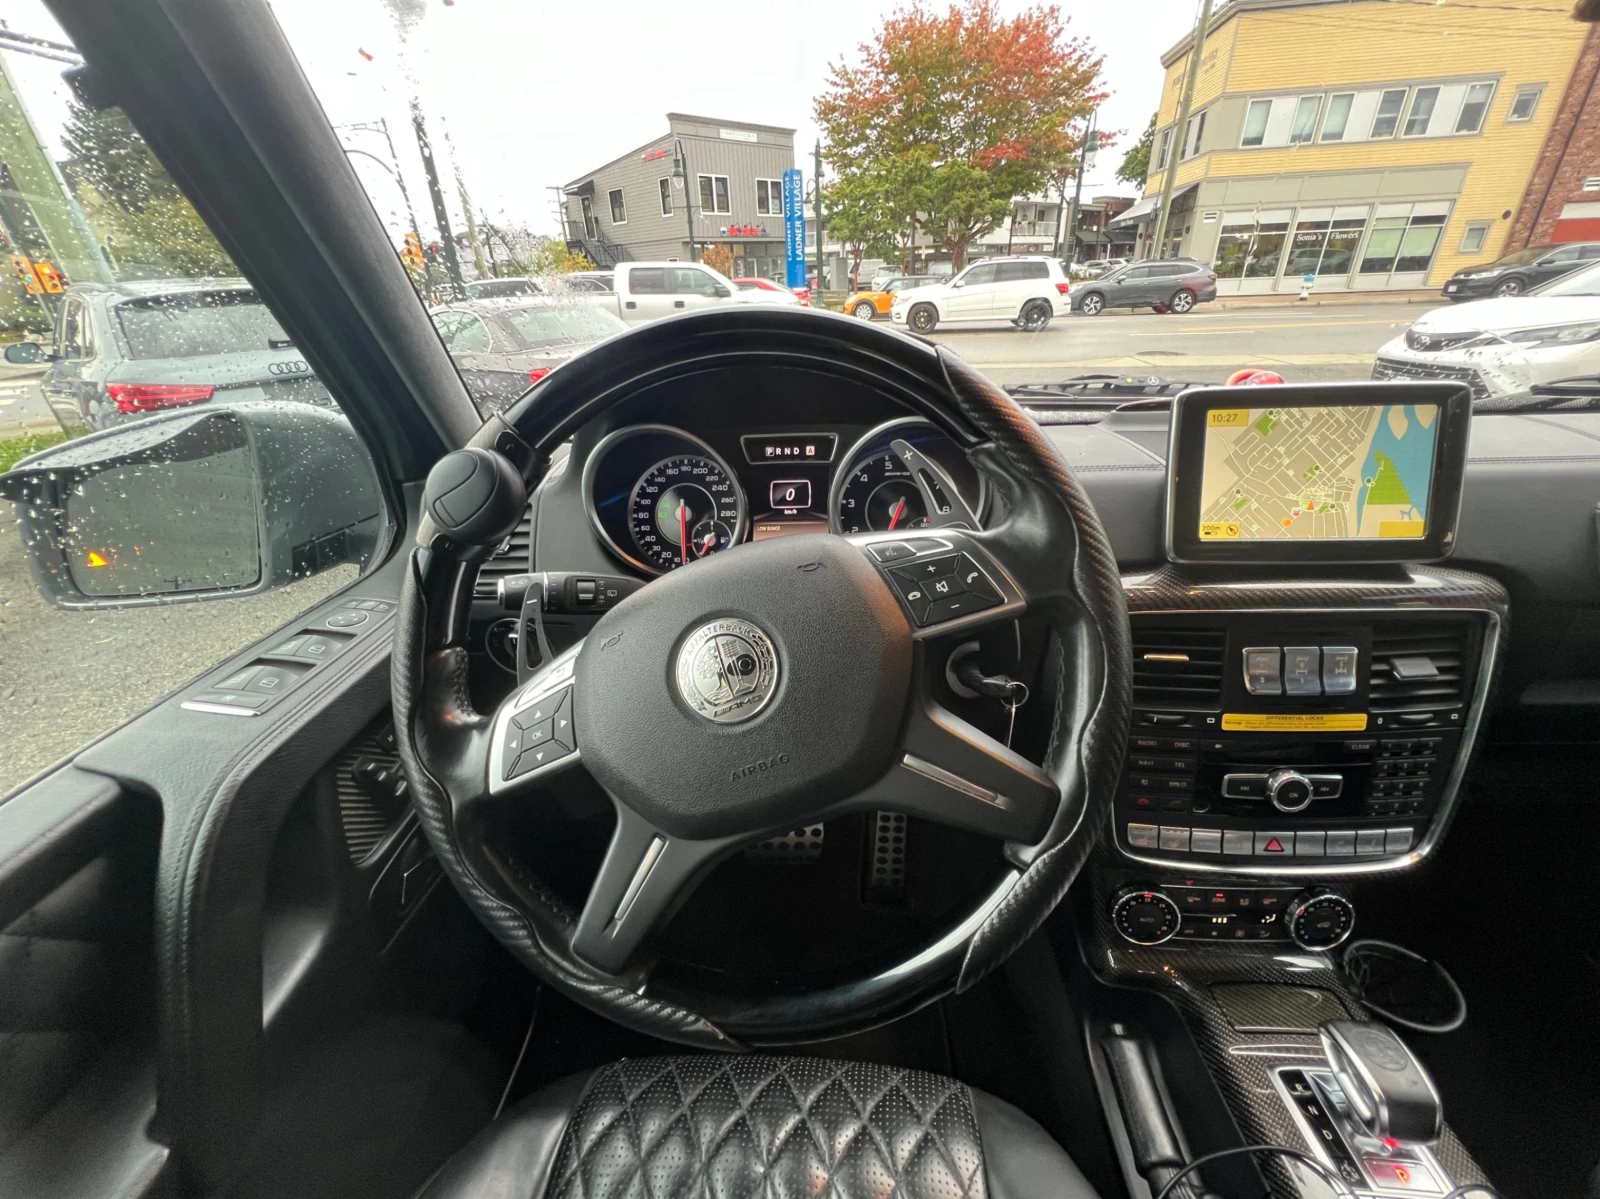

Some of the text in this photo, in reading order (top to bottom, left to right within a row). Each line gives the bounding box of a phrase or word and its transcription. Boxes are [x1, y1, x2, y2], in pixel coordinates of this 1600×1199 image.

[793, 174, 803, 260] LADNER VILLAGE
[1296, 232, 1360, 241] Sonia's Flowers
[1212, 414, 1238, 422] 10:27
[885, 462, 892, 470] 5
[860, 474, 868, 482] 4
[786, 488, 795, 501] 0
[848, 499, 854, 507] 3
[532, 730, 542, 740] OK
[731, 754, 790, 781] AIRBAG
[1295, 1084, 1304, 1093] R
[1308, 1105, 1319, 1116] N
[1322, 1129, 1332, 1140] D
[1395, 1168, 1408, 1185] P
